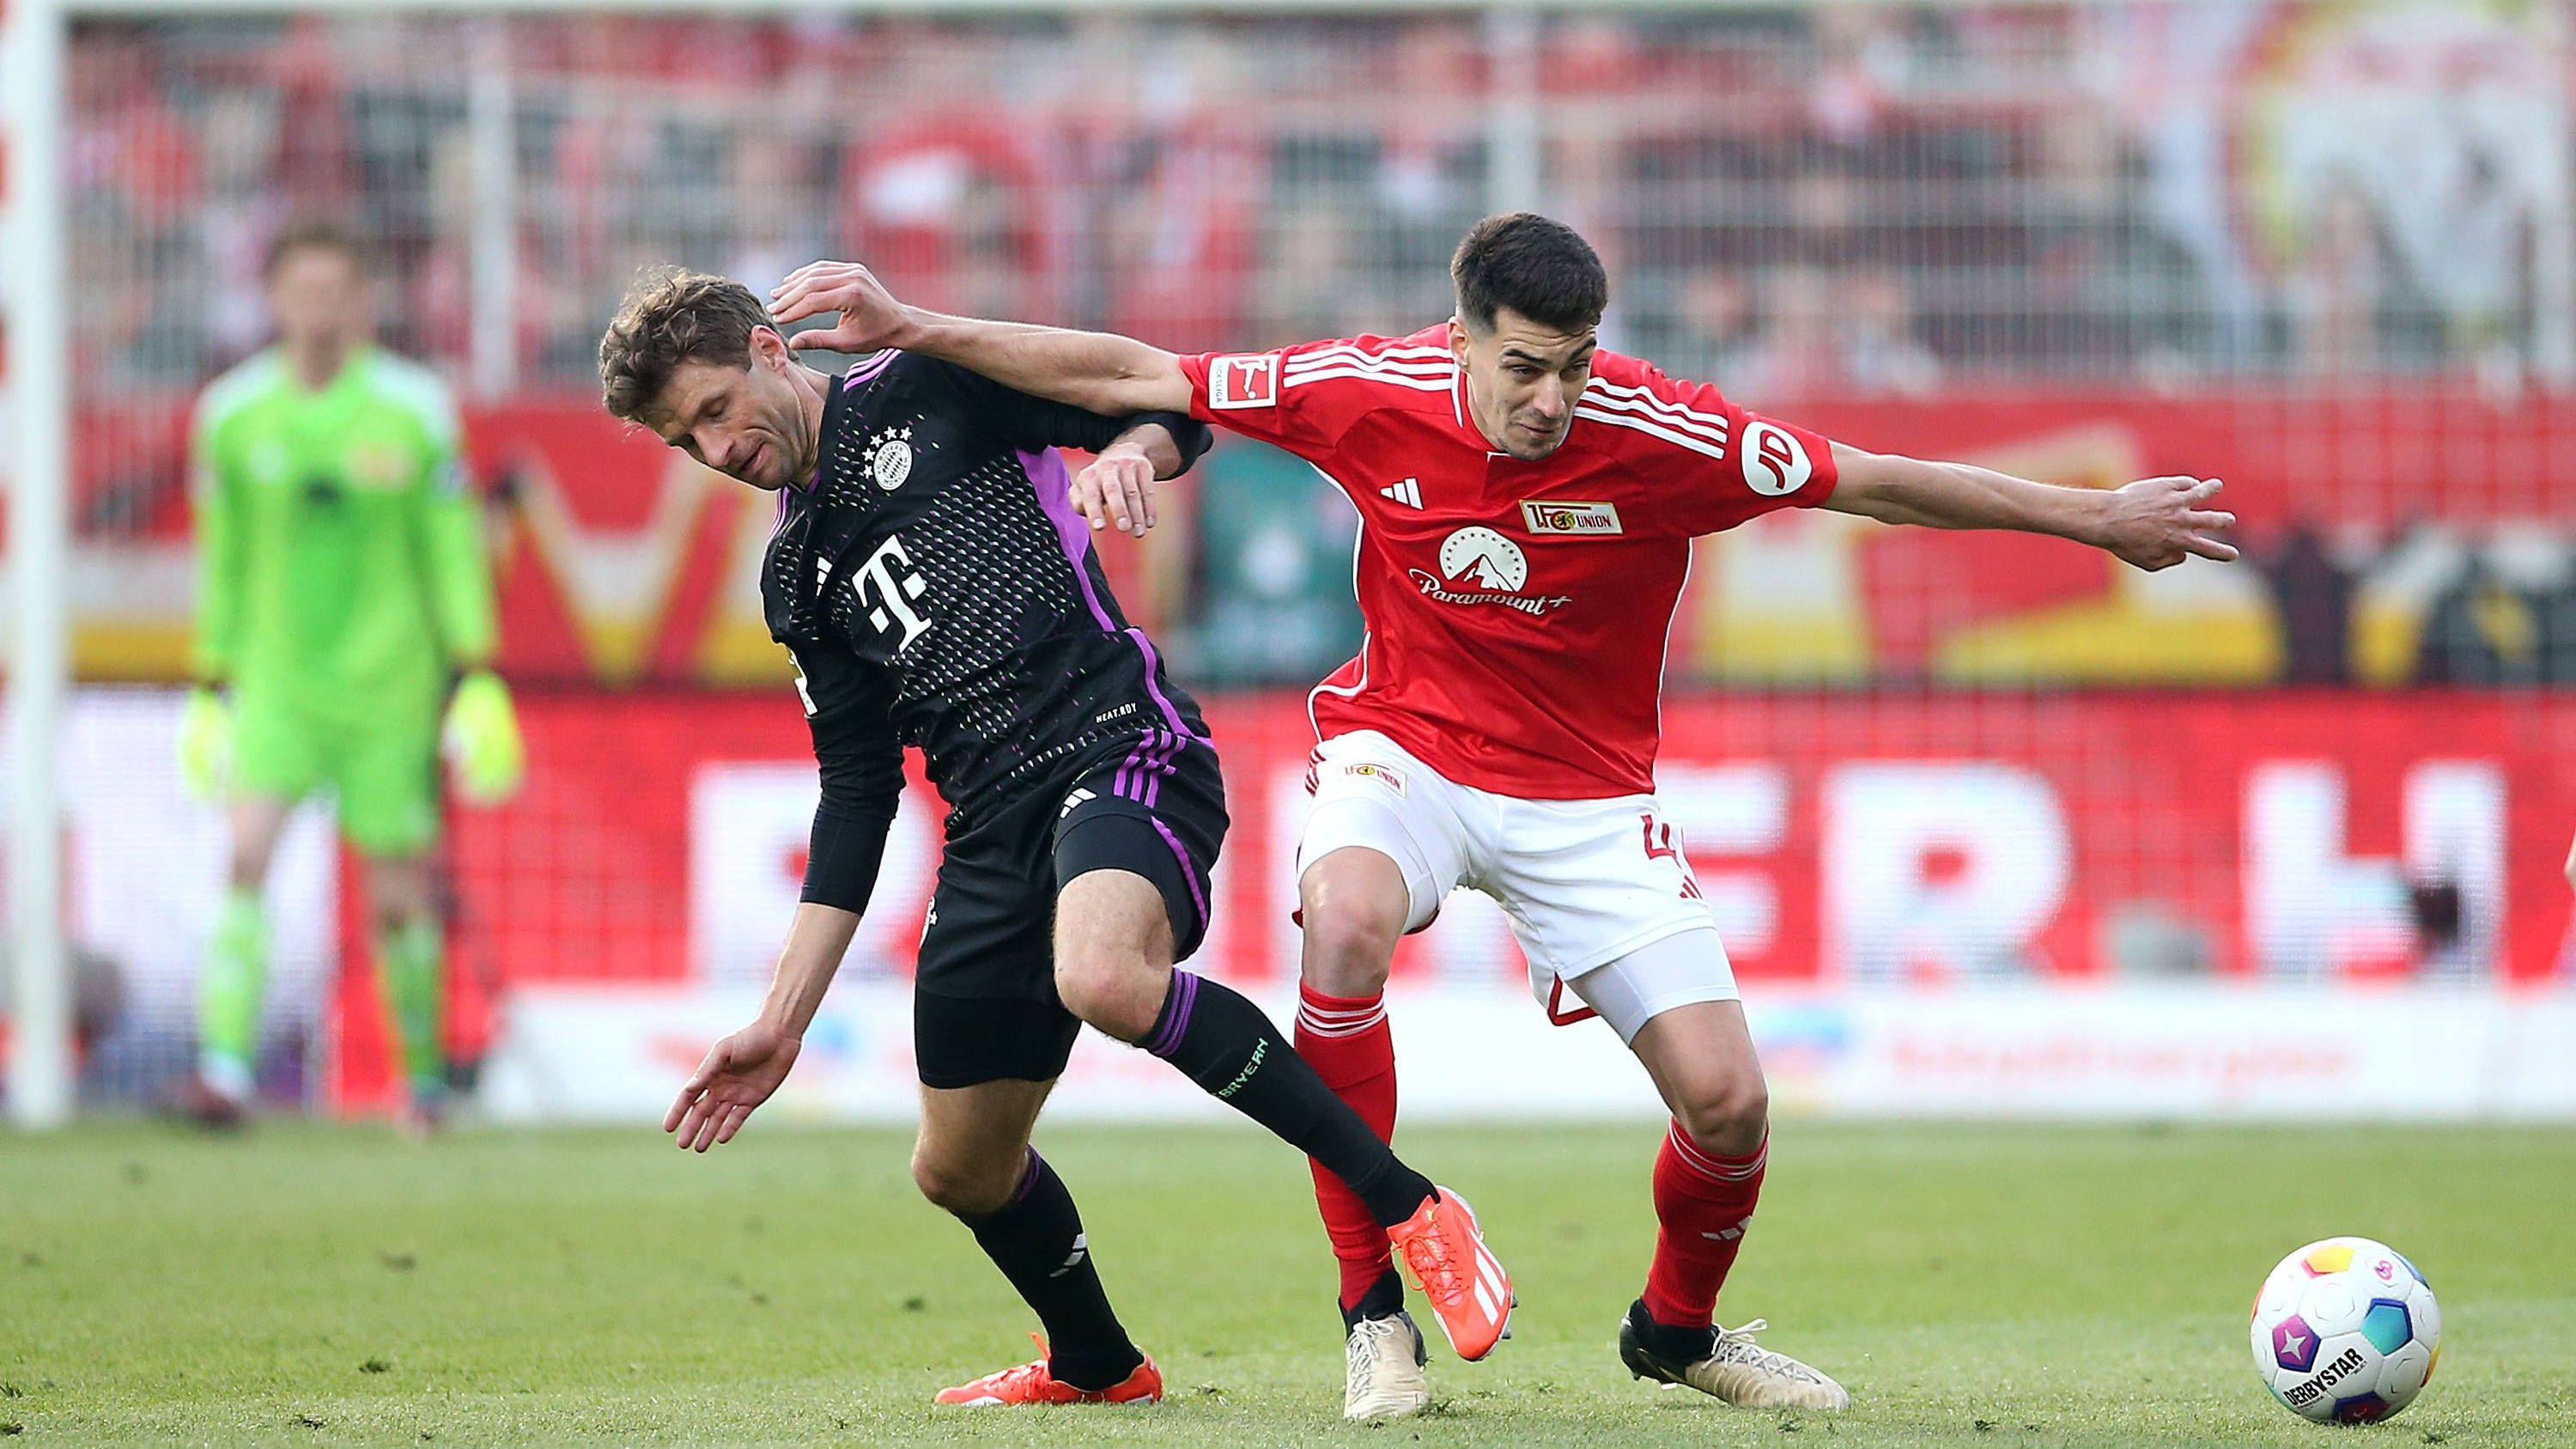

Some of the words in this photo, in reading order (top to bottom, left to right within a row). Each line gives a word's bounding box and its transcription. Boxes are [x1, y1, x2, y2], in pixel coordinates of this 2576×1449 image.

[1759, 429, 1793, 490] JD
[1577, 514, 1612, 528] UNION
[1408, 568, 1572, 616] Paramount+
[1096, 702, 1137, 723] HEAT.RDY
[1376, 770, 1400, 789] UNION
[1640, 813, 1678, 861] 4
[1218, 1037, 1269, 1098] BAYERN
[2283, 1347, 2365, 1406] DERBYSTAR
